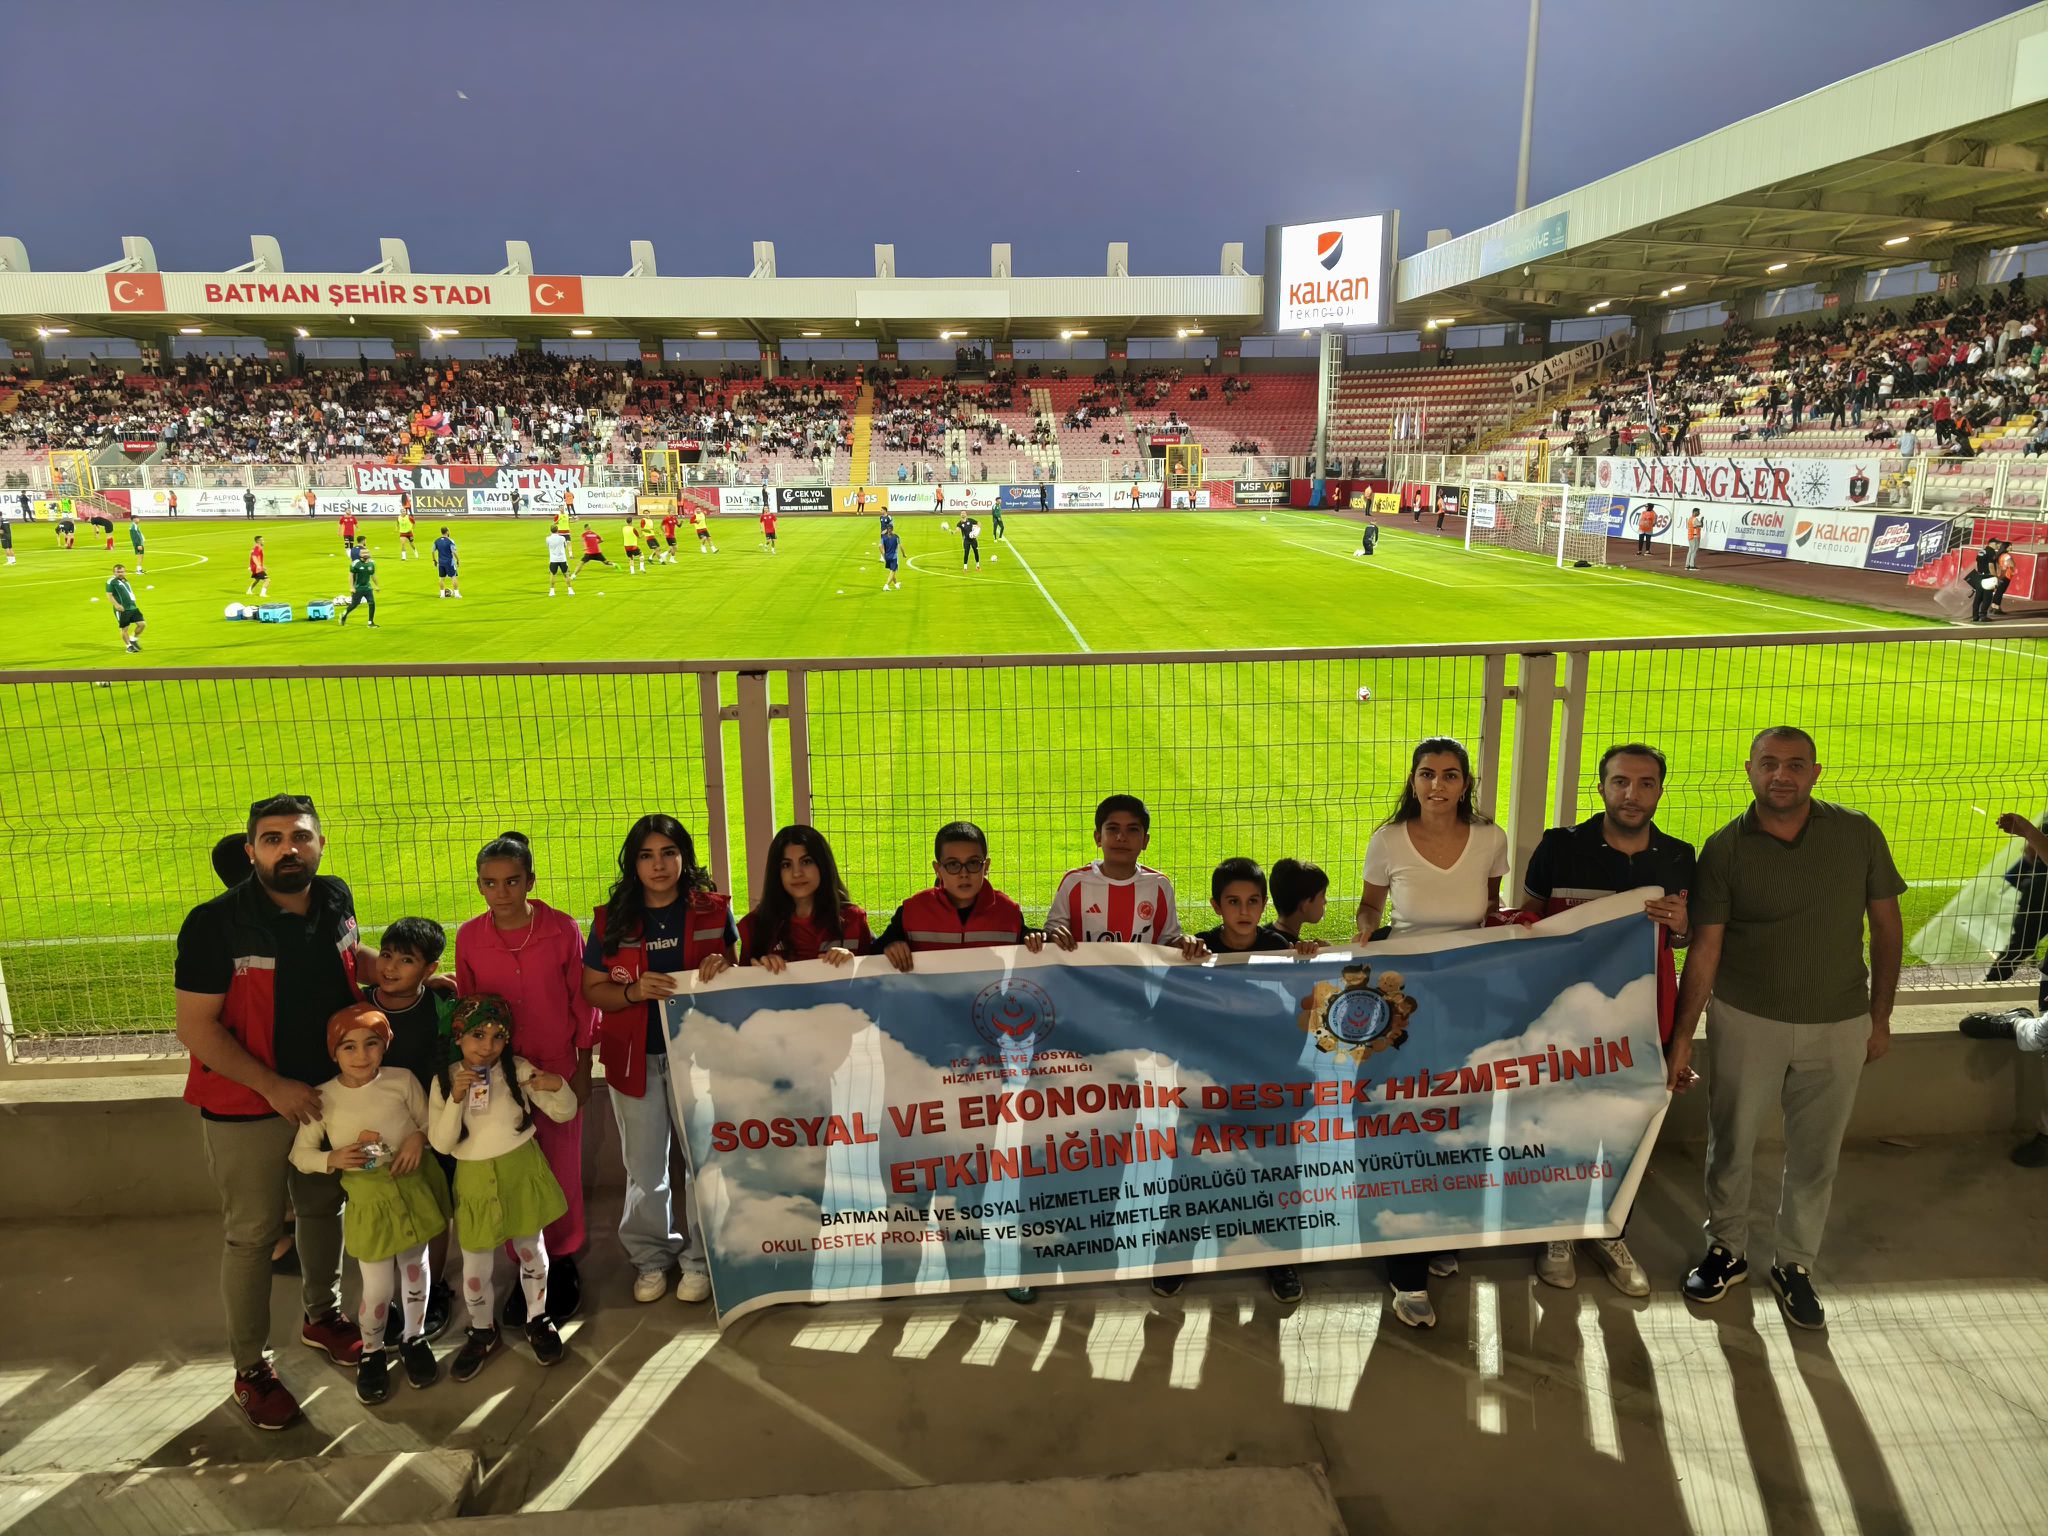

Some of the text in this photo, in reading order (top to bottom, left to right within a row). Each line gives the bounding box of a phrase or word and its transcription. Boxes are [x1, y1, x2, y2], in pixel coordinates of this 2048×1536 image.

[205, 281, 492, 307] BATMAN ŞEHİR STADI
[357, 467, 450, 492] BATS ON
[496, 468, 582, 489] ATTACK
[1240, 482, 1261, 491] MSF
[415, 496, 465, 508] KINAY
[587, 491, 622, 499] Dentplus
[950, 498, 968, 508] Dinç
[971, 499, 993, 510] Grup
[1374, 497, 1396, 511] NESİNE
[1751, 511, 1784, 529] ENGİN
[950, 1050, 1083, 1069] T.C. AİLE VE SOSYAL
[942, 1062, 1093, 1085] HİZMETLER BAKANLIĞI
[711, 1035, 1634, 1152] SOSYAL VE EKONOMİK DESTEK HİZMETİNİN
[889, 1105, 1460, 1194] ETKİNLİĞİNİN ARTIRILMASI
[820, 1143, 1546, 1227] BATMAN AİLE VE SOSYAL HİZMETLER İL MÜDÜRLÜĞÜ TARAFINDAN YÜRÜTÜLMEKTE OLAN
[761, 1160, 1614, 1254] OKUL DESTEK PROJESİ AİLE VE SOSYAL HİZMETLER BAKANLIĞI ÇOCUK HİZMETLERİ GENEL MÜDÜRLÜĞÜ
[1033, 1211, 1341, 1259] TARAFINDAN FİNANSE EDİLMEKTEDİR.
